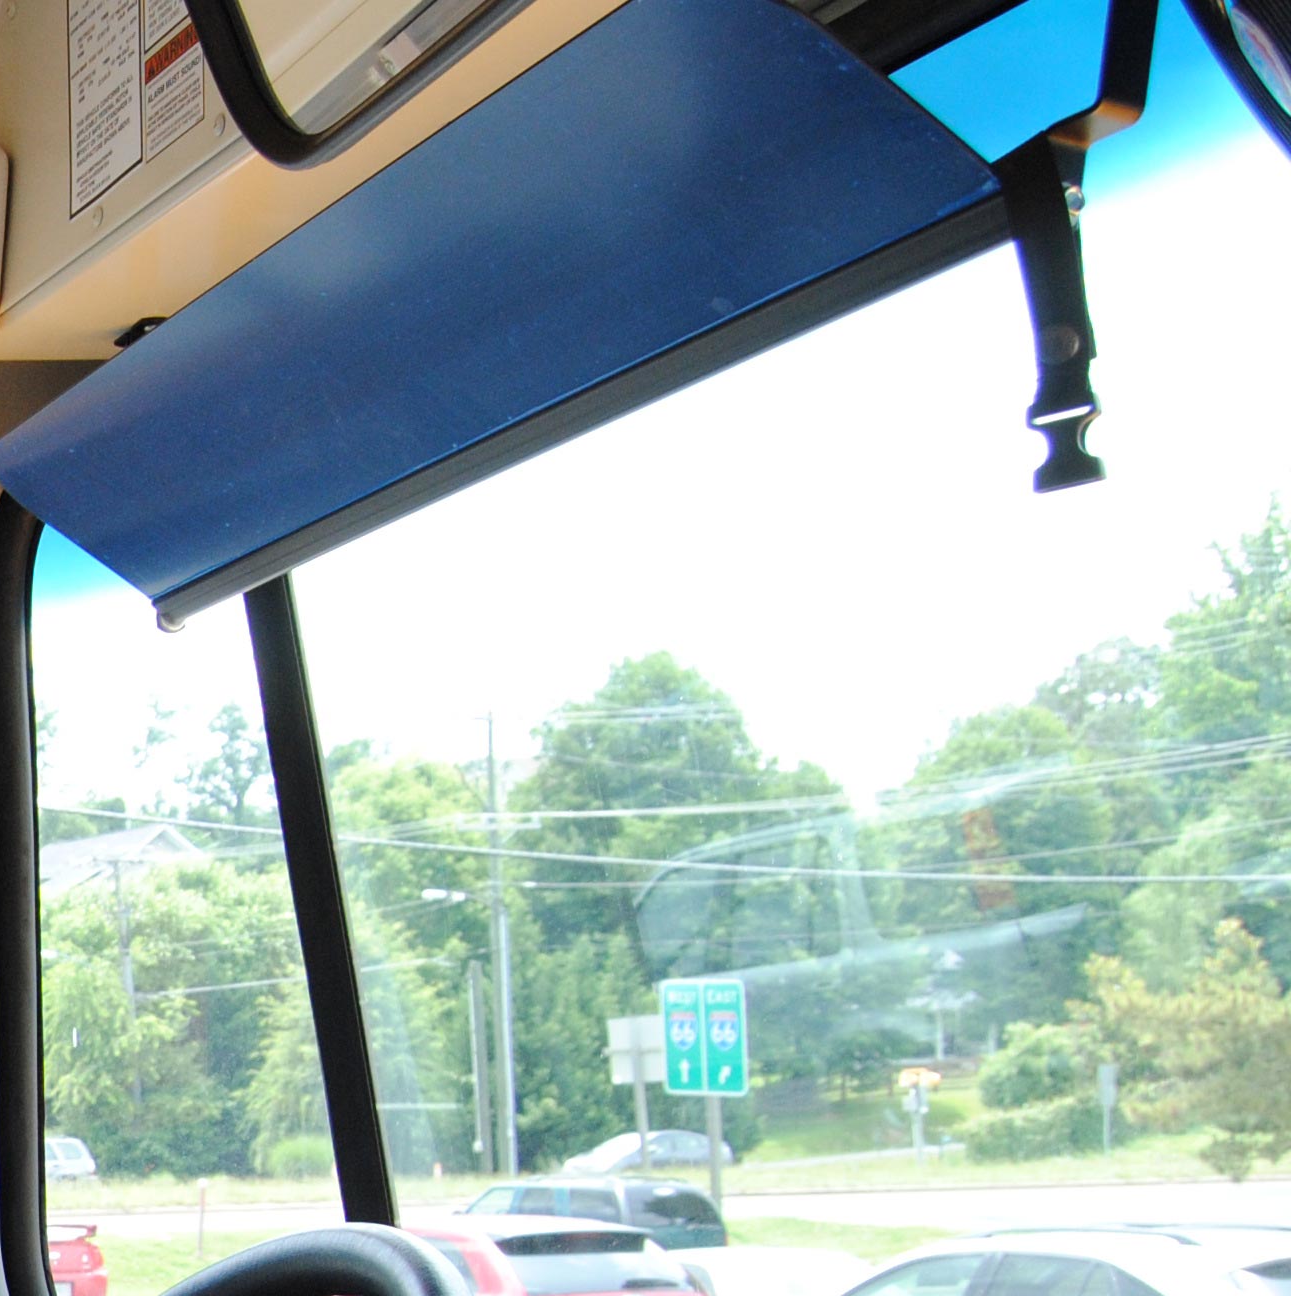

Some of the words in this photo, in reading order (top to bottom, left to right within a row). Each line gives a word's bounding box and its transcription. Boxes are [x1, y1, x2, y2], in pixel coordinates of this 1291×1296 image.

[156, 28, 197, 66] WARNIN
[706, 989, 737, 1004] EAST
[670, 1020, 696, 1042] 66
[710, 1020, 738, 1042] 66
